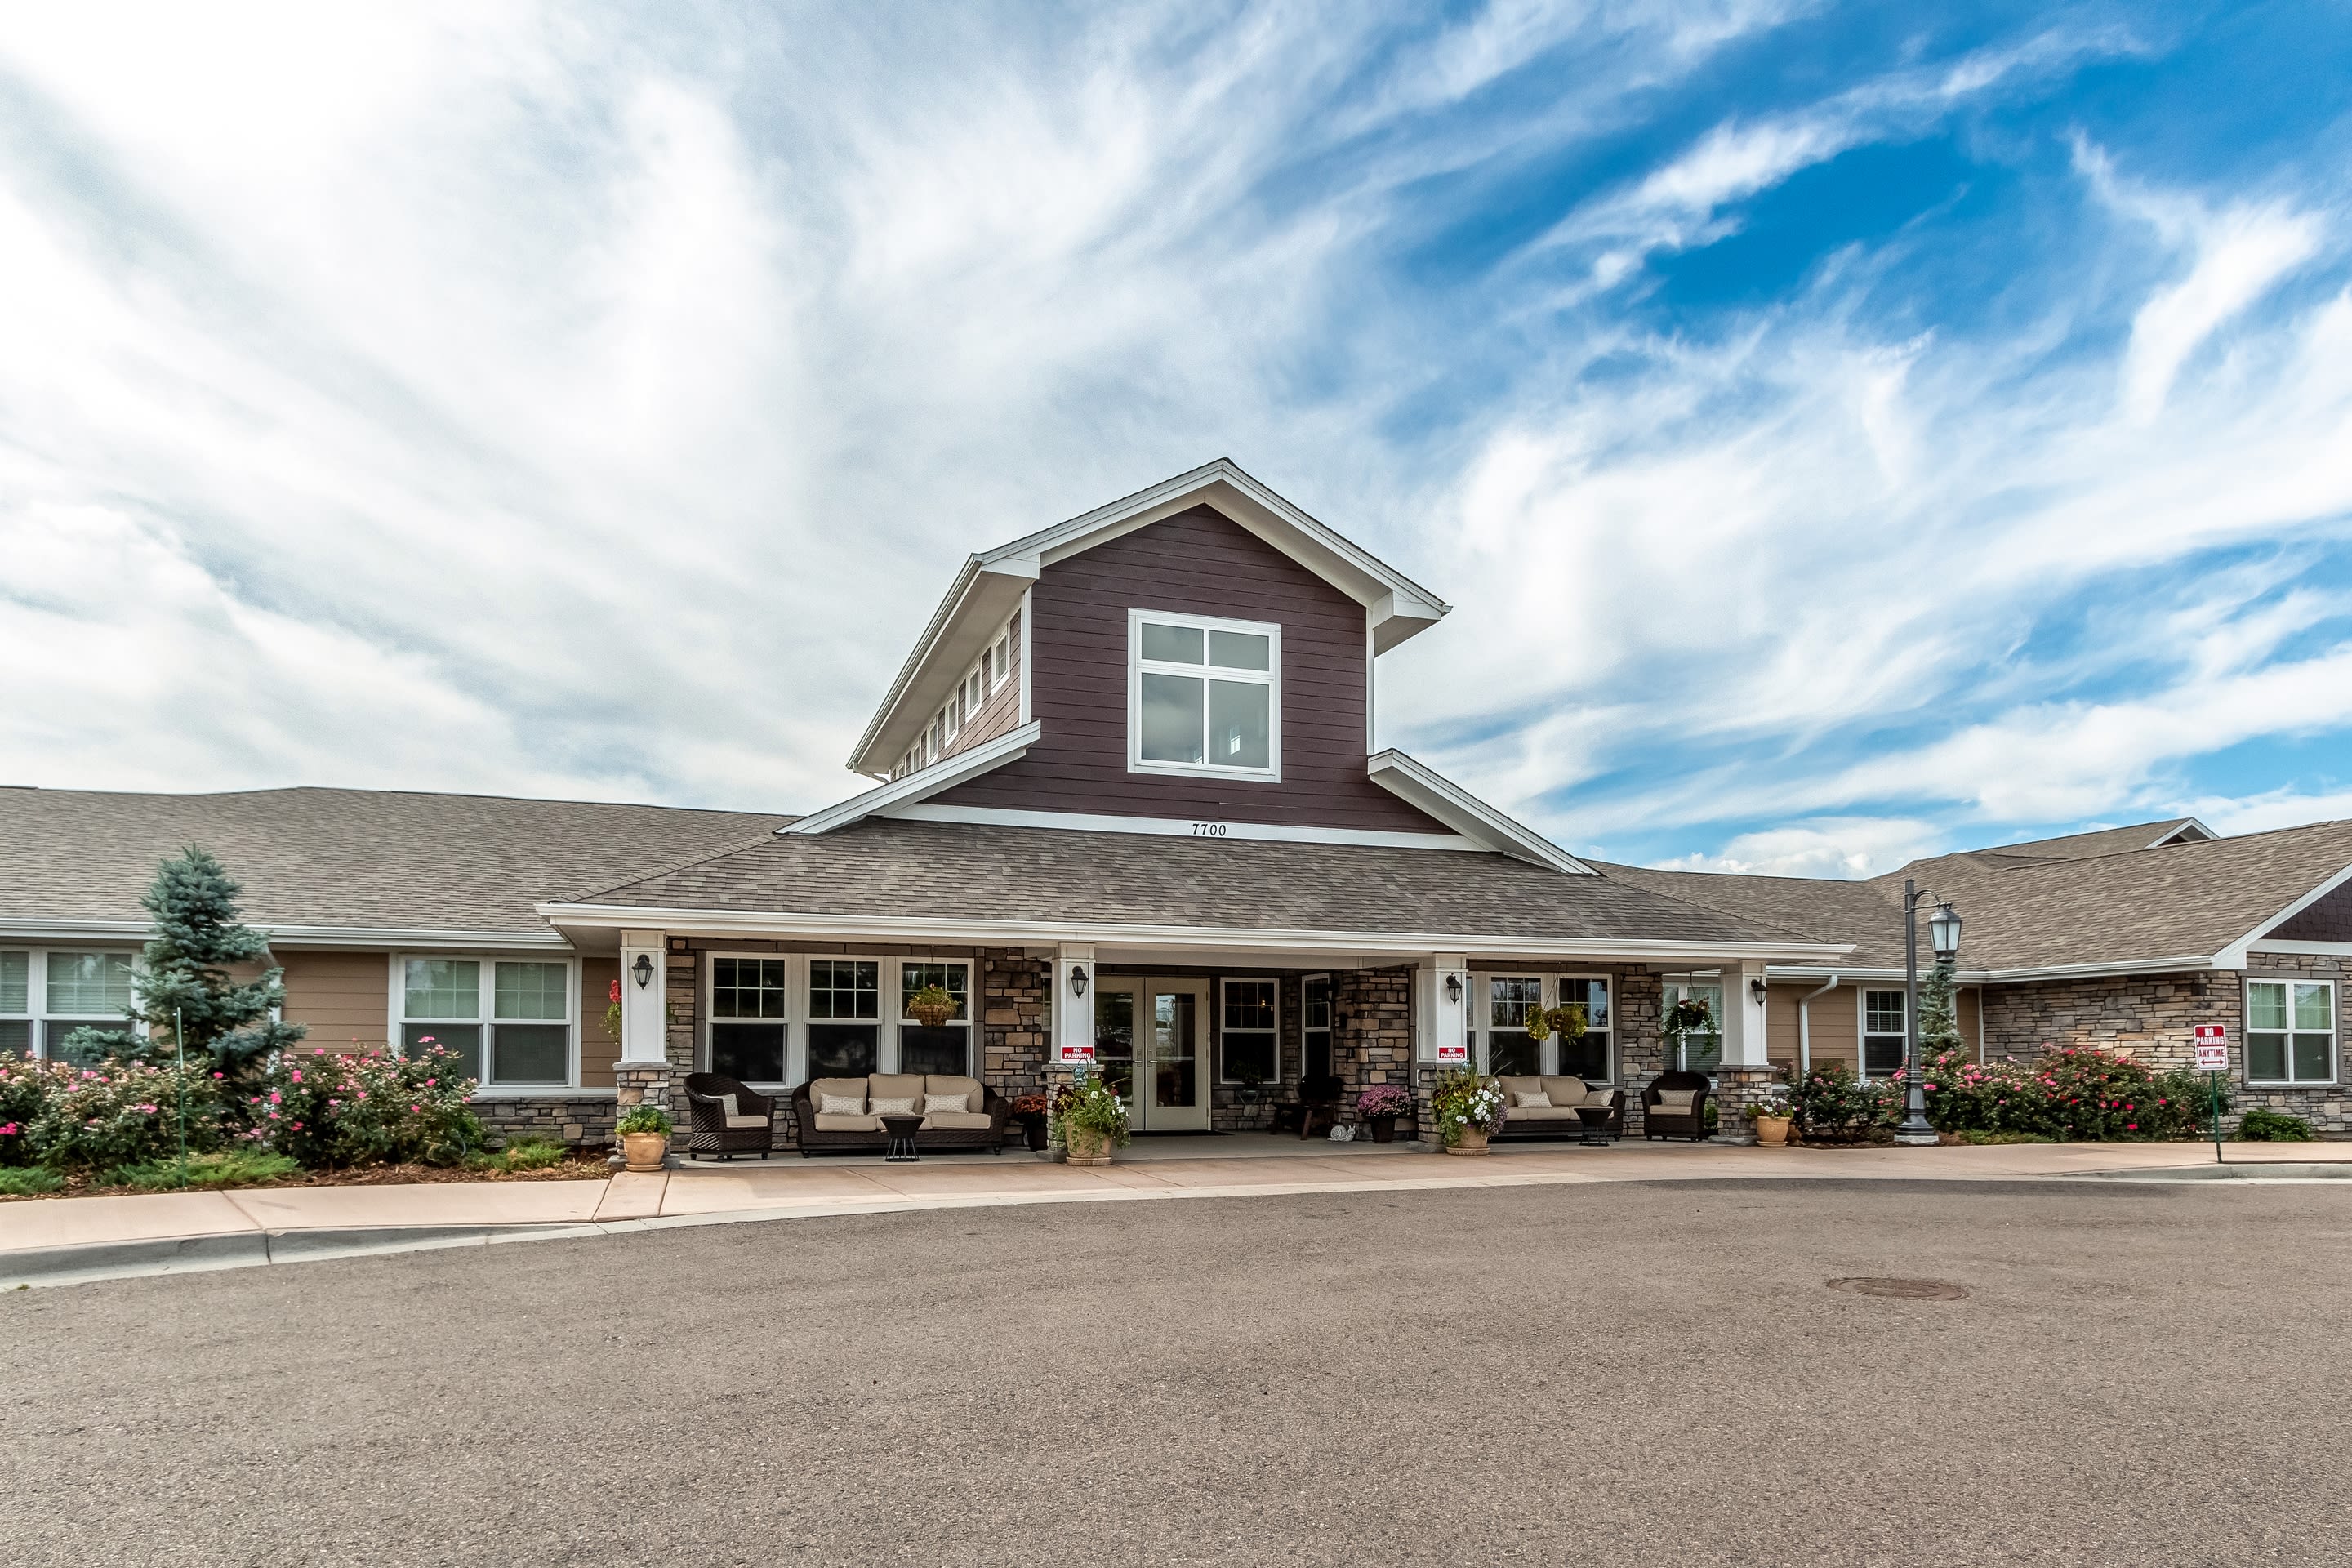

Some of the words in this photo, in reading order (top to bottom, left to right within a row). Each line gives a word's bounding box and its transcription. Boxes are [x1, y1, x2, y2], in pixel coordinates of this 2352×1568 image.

[1192, 823, 1226, 836] 7700
[2205, 1027, 2214, 1036] NO
[2197, 1036, 2224, 1045] PARKING
